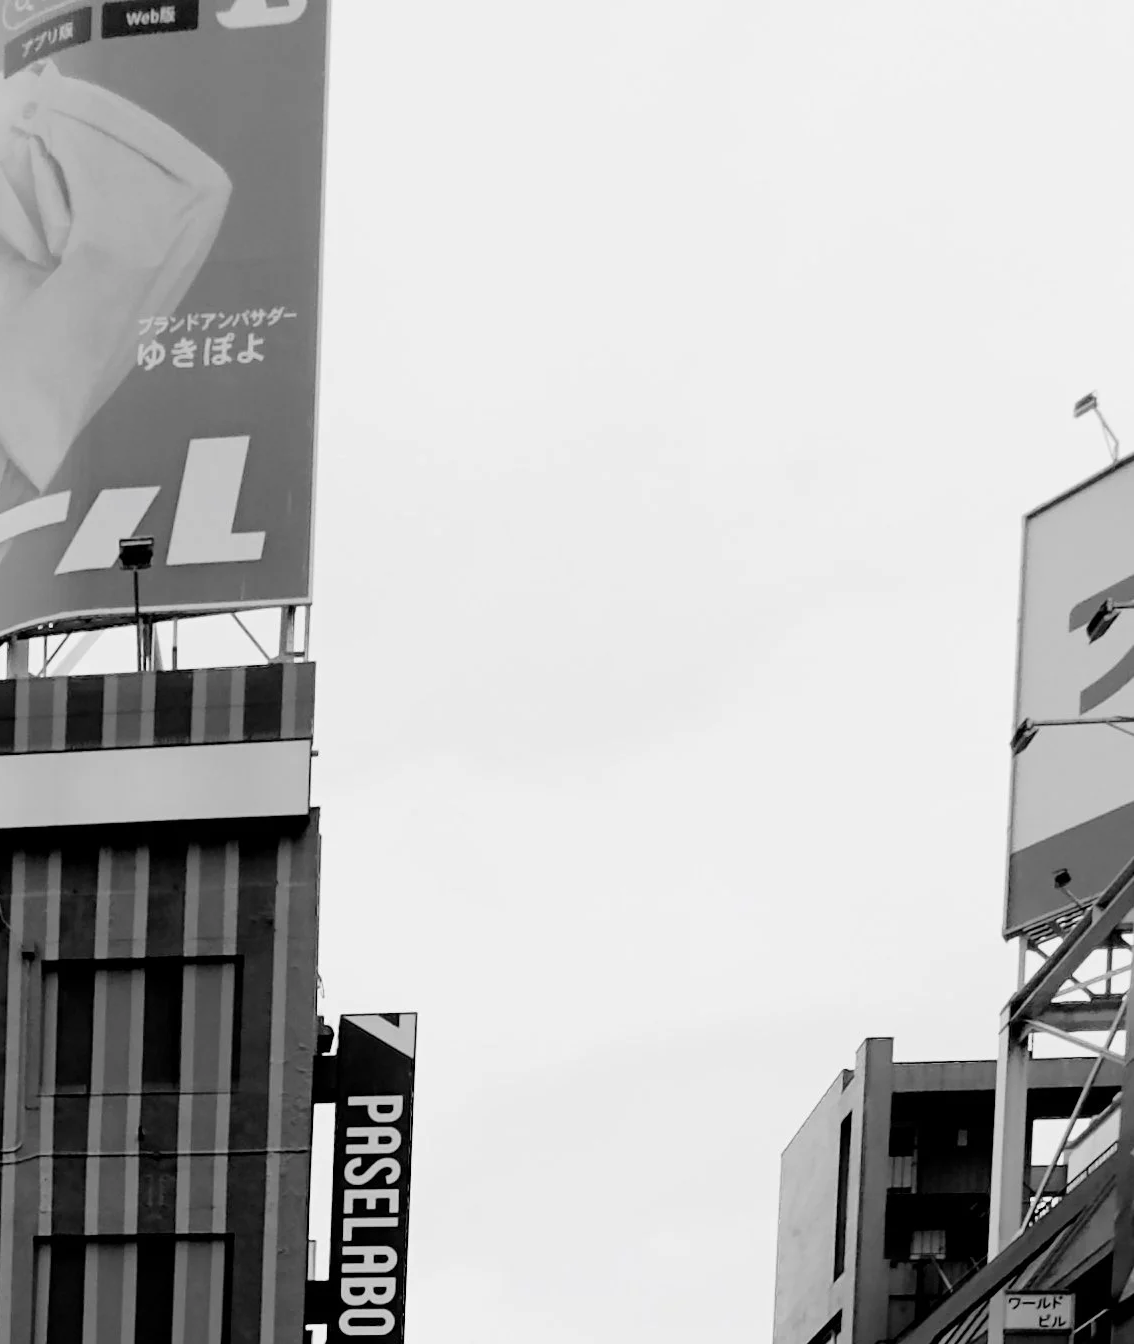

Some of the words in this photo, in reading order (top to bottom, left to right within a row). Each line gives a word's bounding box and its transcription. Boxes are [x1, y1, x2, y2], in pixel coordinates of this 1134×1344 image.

[126, 6, 176, 26] Web版
[138, 306, 298, 336] ブランドアンバサダー
[137, 332, 265, 372] ゆきぽよ
[338, 1095, 404, 1336] PASELABO
[1008, 1297, 1063, 1310] ワールド
[1039, 1314, 1067, 1328] ビル
